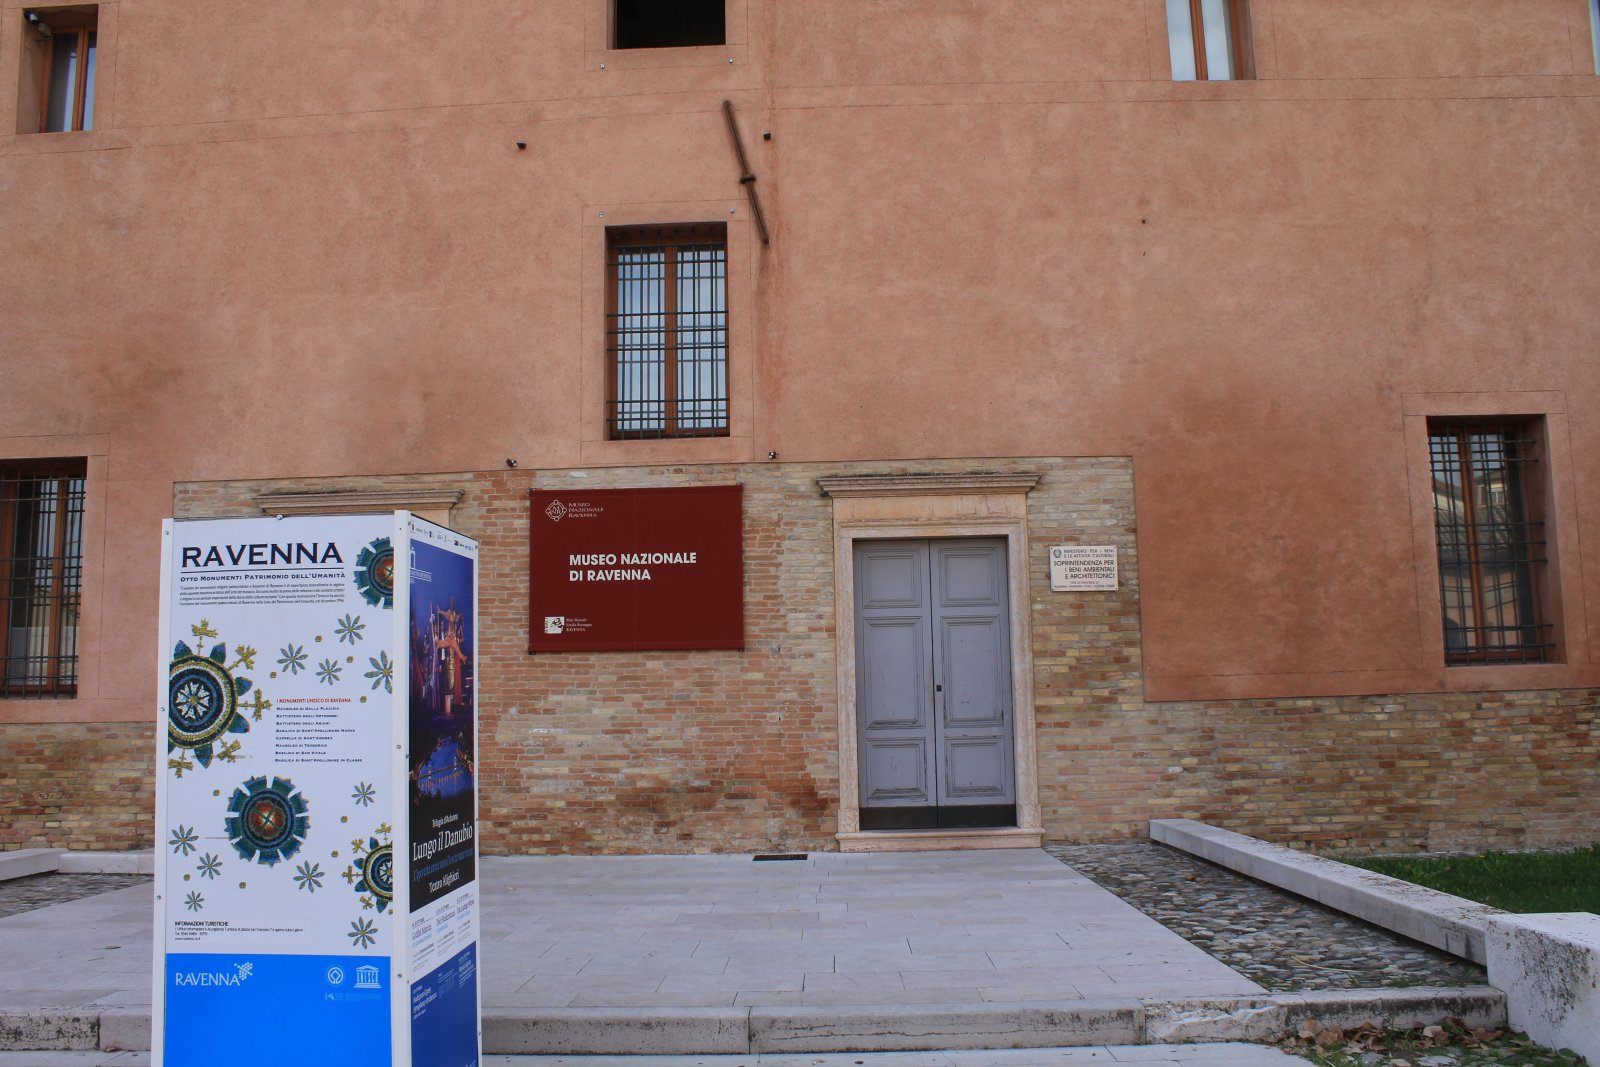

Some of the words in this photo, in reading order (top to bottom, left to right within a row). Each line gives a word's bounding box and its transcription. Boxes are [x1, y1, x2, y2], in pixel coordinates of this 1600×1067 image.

[181, 542, 345, 568] RAVENNA
[569, 554, 617, 566] MUSEO
[620, 552, 697, 565] NAZIONALE
[569, 570, 583, 582] DI
[587, 568, 652, 582] RAVENNA
[412, 838, 437, 862] Lungo
[438, 830, 444, 851] il
[444, 821, 473, 850] Danubio
[428, 879, 442, 893] Teatro
[175, 971, 241, 987] RAVENNA
